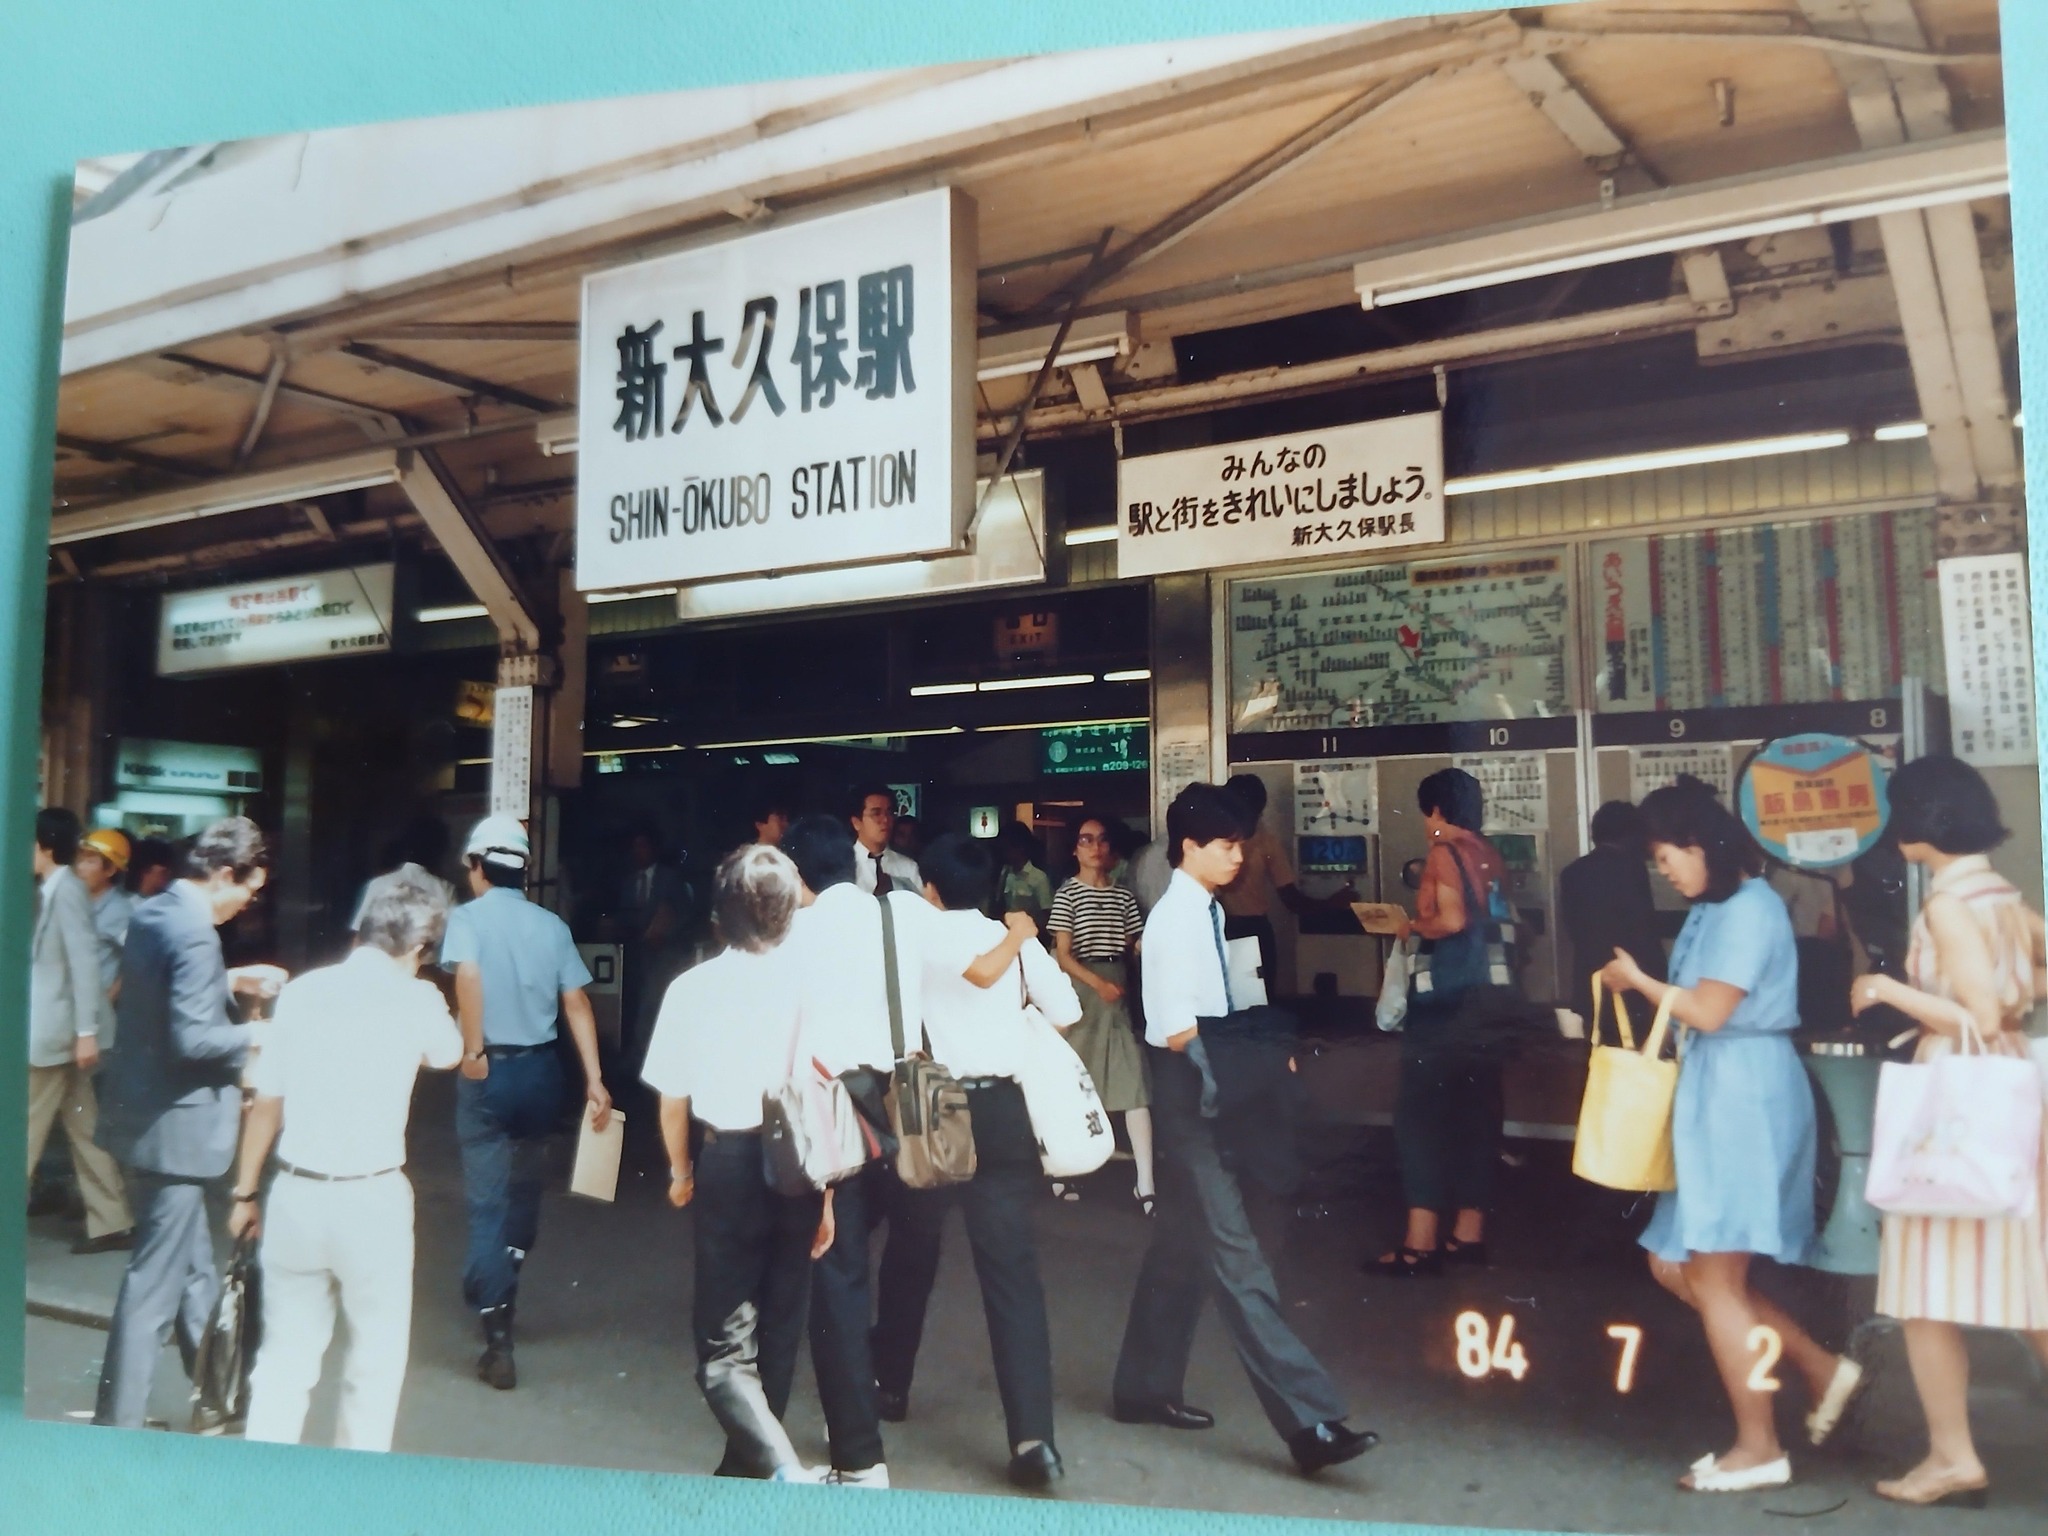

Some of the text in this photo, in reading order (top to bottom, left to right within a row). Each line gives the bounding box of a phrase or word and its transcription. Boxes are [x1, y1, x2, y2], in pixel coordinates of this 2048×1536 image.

[613, 263, 916, 442] 新大久保駅
[1221, 443, 1326, 482] みんなの
[610, 449, 917, 544] SHIN-ŌKUBO STATION
[1128, 466, 1433, 538] 駅と街をきれいにしましょう。
[1291, 512, 1415, 546] 新大久保駅長
[1009, 632, 1043, 645] EXIT
[1669, 718, 1686, 738] 9
[1870, 708, 1887, 728] 8
[1322, 736, 1338, 753] 11
[1489, 727, 1510, 746] 10
